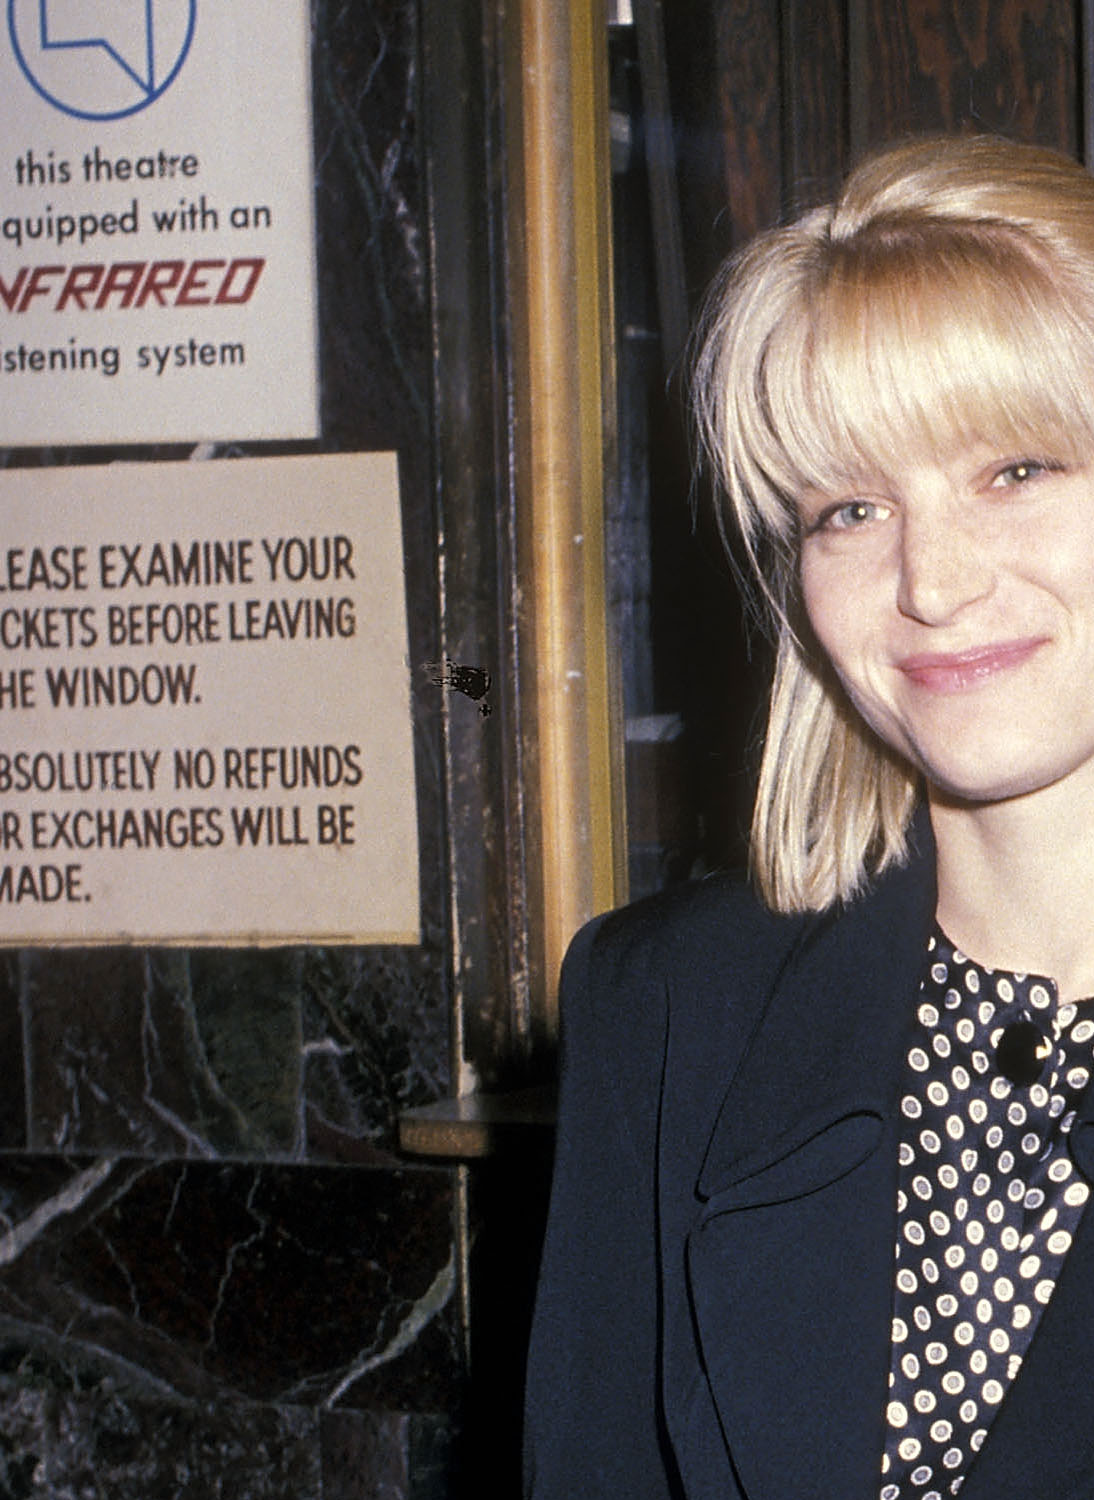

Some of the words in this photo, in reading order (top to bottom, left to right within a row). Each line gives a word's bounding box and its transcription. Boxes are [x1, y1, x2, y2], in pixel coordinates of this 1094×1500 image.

[15, 150, 71, 185] this
[83, 146, 199, 183] theatre
[0, 198, 139, 247] quipped
[152, 196, 218, 234] with
[230, 205, 271, 230] an
[0, 338, 119, 376] stening
[138, 339, 245, 377] system
[100, 541, 254, 589] EXAMINE
[261, 536, 356, 582] YOUR
[0, 605, 97, 649] CKETS
[109, 602, 221, 647] BEFORE
[229, 597, 356, 642] LEAVING
[46, 665, 202, 709] WINDOW.
[174, 748, 216, 790] NO
[225, 745, 363, 790] REFUNDS
[0, 811, 24, 850] R
[32, 807, 224, 850] EXCHANGES
[231, 806, 309, 846] WILL
[317, 804, 356, 846] BE
